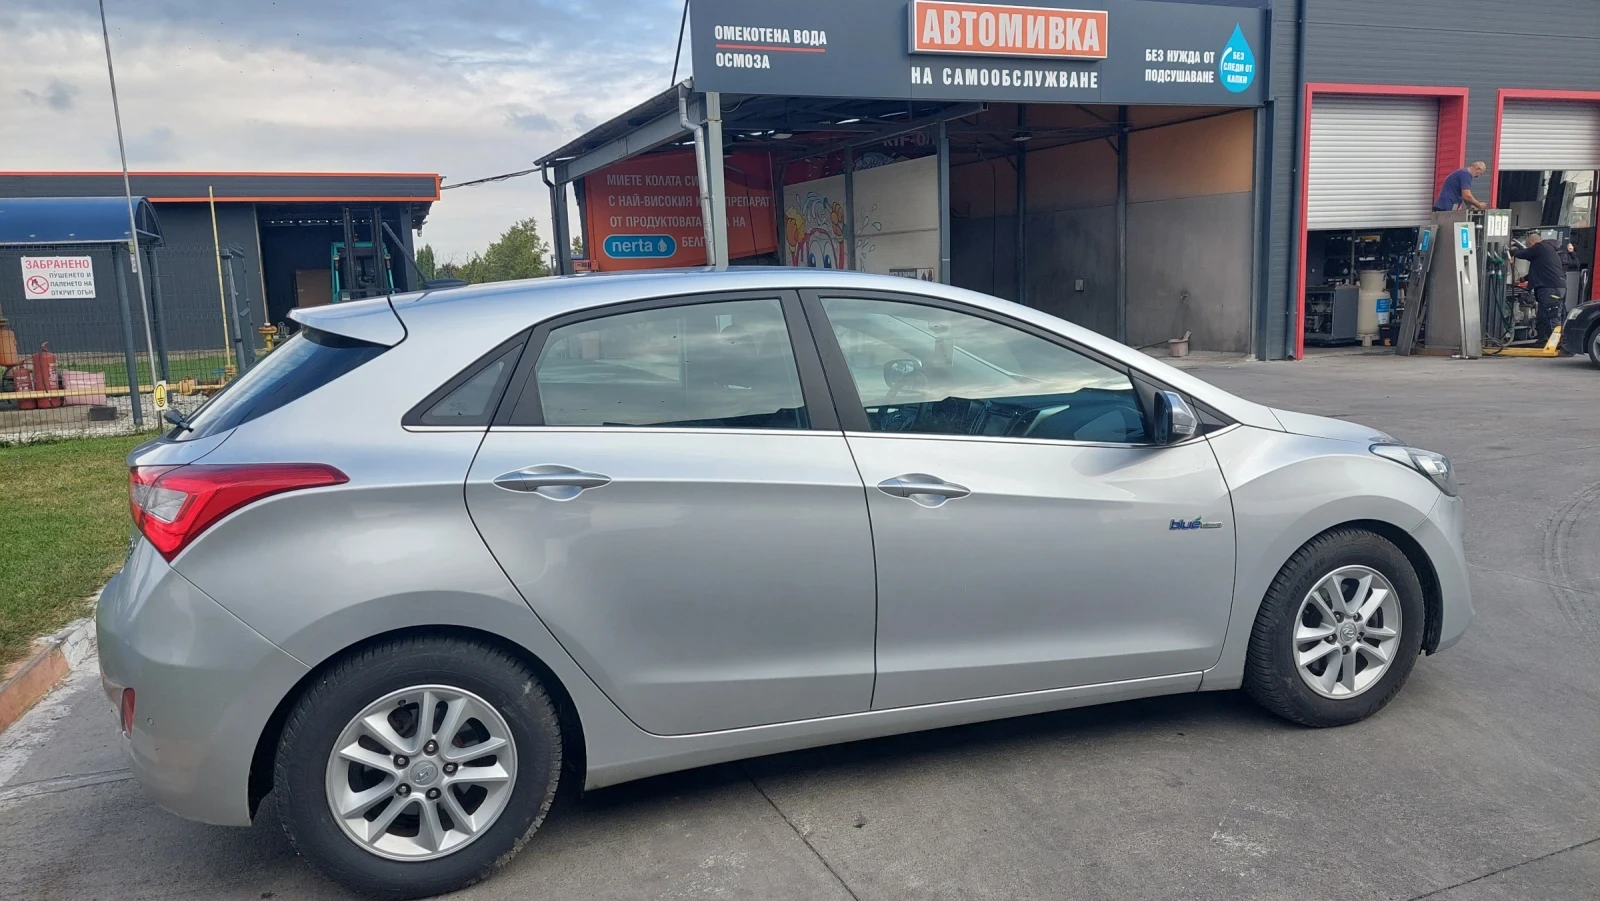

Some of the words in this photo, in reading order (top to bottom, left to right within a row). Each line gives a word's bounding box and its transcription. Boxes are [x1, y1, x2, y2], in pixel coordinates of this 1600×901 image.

[714, 25, 791, 43] ОМЕКОТЕНА
[793, 29, 828, 46] ВОДА
[922, 9, 1100, 52] АВТОМИВКА
[715, 52, 771, 69] ОСМОЗА
[1145, 49, 1164, 62] БЕЗ
[1167, 50, 1201, 64] НУЖДА
[1203, 51, 1215, 64] ОТ
[1232, 52, 1245, 60] БЕЗ
[1223, 62, 1244, 72] СЛЕДИ
[1245, 64, 1253, 73] ОТ
[911, 67, 933, 85] НА
[942, 68, 1098, 89] САМООБСЛУЖВАНЕ
[1145, 69, 1214, 83] ПОДСУШАВАНЕ
[1227, 75, 1247, 84] КАПКИ
[606, 174, 643, 186] МИЕТЕ
[645, 175, 682, 187] КОЛАТА
[608, 195, 616, 207] С
[618, 193, 693, 207] НАЙ-ВИСОКИЯ
[610, 216, 623, 228] ОТ
[626, 216, 702, 229] ПРОДУКТОВАТА
[732, 216, 746, 227] НА
[612, 239, 653, 252] nerta
[25, 259, 89, 269] ЗАБРАНЕНО
[1169, 518, 1201, 530] blue
